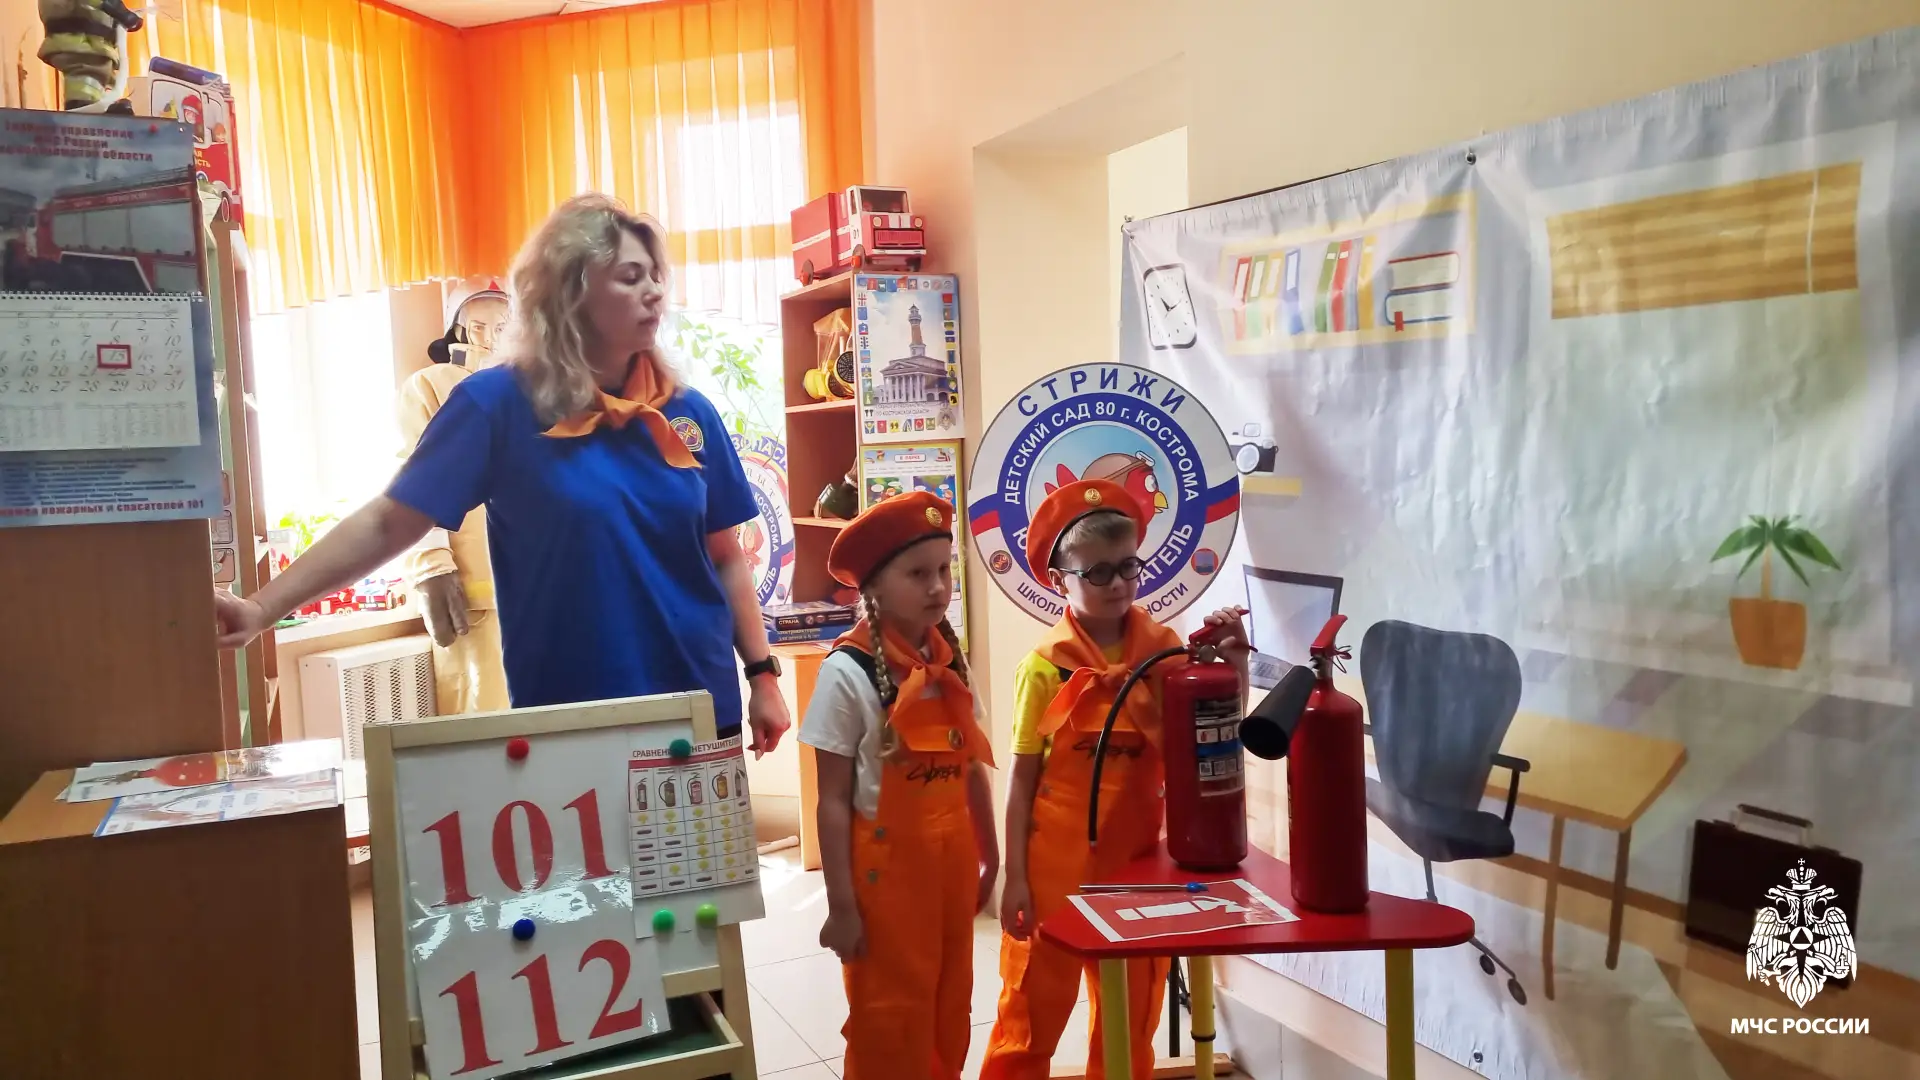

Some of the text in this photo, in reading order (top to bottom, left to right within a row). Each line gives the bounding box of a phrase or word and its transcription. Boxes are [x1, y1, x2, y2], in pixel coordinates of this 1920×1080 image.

[165, 335, 181, 346] 10
[1018, 368, 1186, 417] СТРИЖИ
[1004, 401, 1200, 505] ДЕТСКИЙ САД 80 г. КОСТРОМА
[117, 501, 184, 512] спасателей
[753, 492, 779, 553] КОСТРОМА
[1017, 582, 1064, 617] ШКОЛА
[632, 749, 672, 758] СРАВНЕН
[422, 787, 620, 908] 101
[438, 939, 643, 1076] 112
